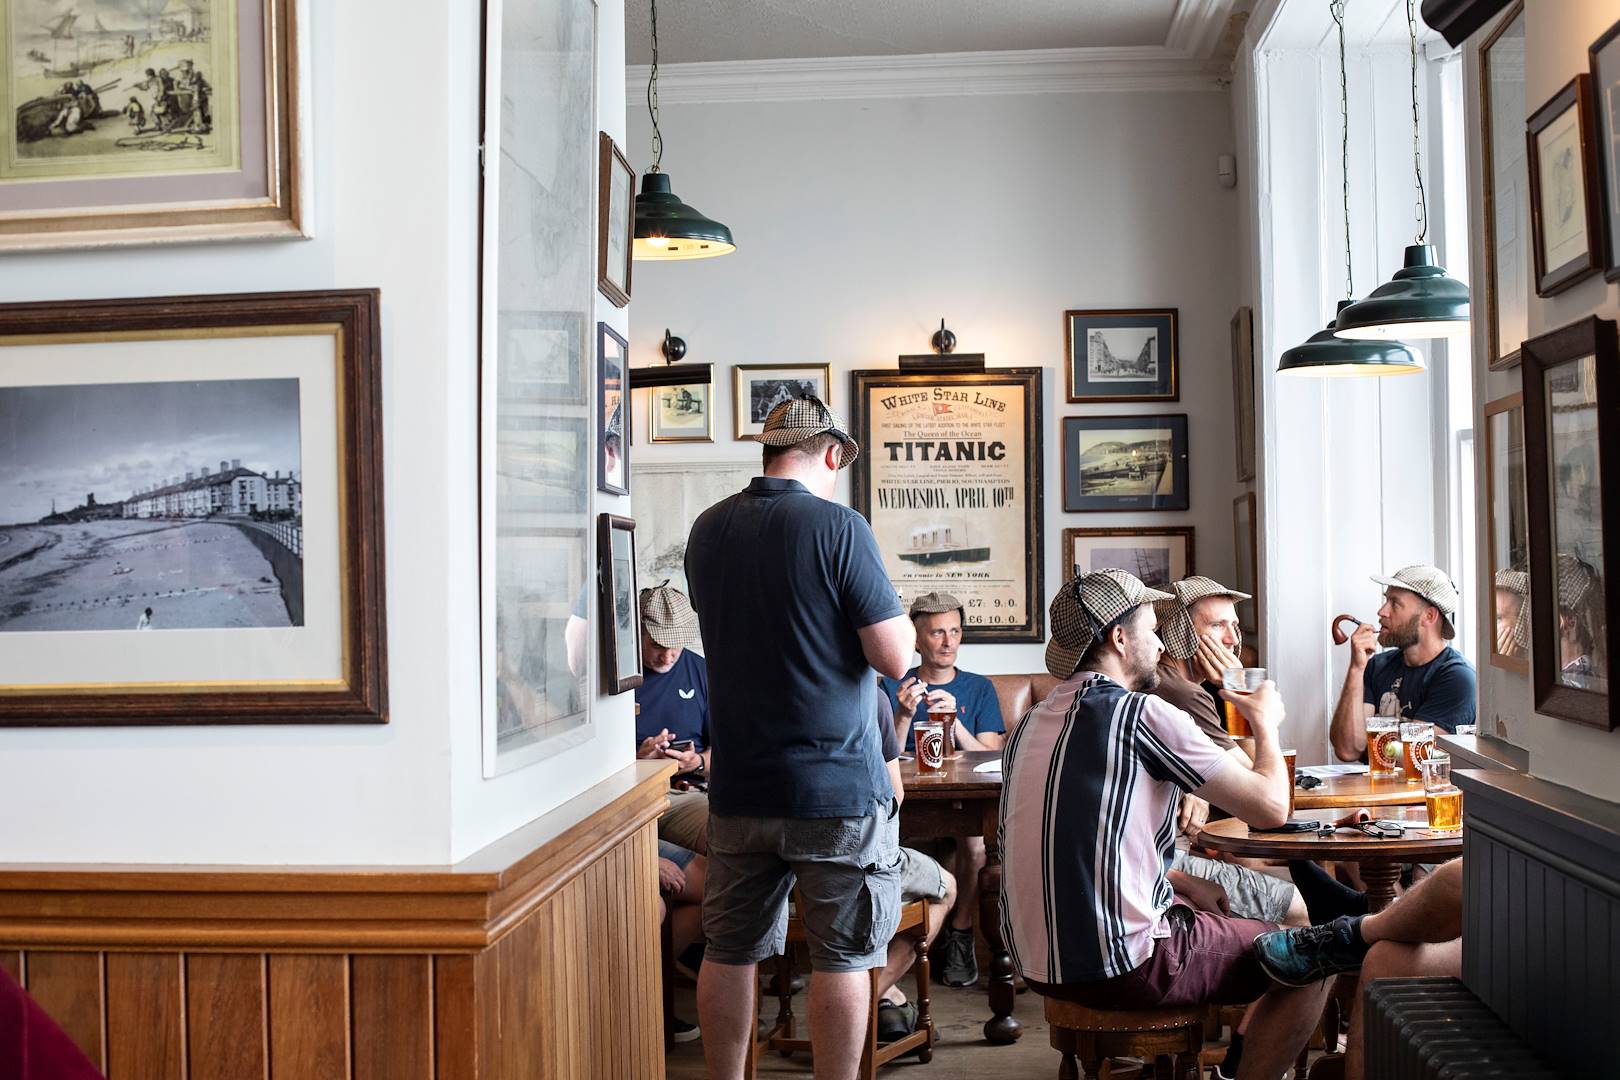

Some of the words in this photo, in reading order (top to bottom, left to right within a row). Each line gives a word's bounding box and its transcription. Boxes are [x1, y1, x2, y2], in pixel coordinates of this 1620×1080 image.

[881, 392, 928, 410] WHITE
[933, 387, 968, 402] STAR
[973, 391, 1006, 412] LINE
[917, 430, 938, 438] Queen
[883, 441, 1006, 461] TITANIC
[878, 487, 949, 509] WEDNESDAY,
[955, 487, 988, 508] APRIL
[931, 741, 941, 757] W
